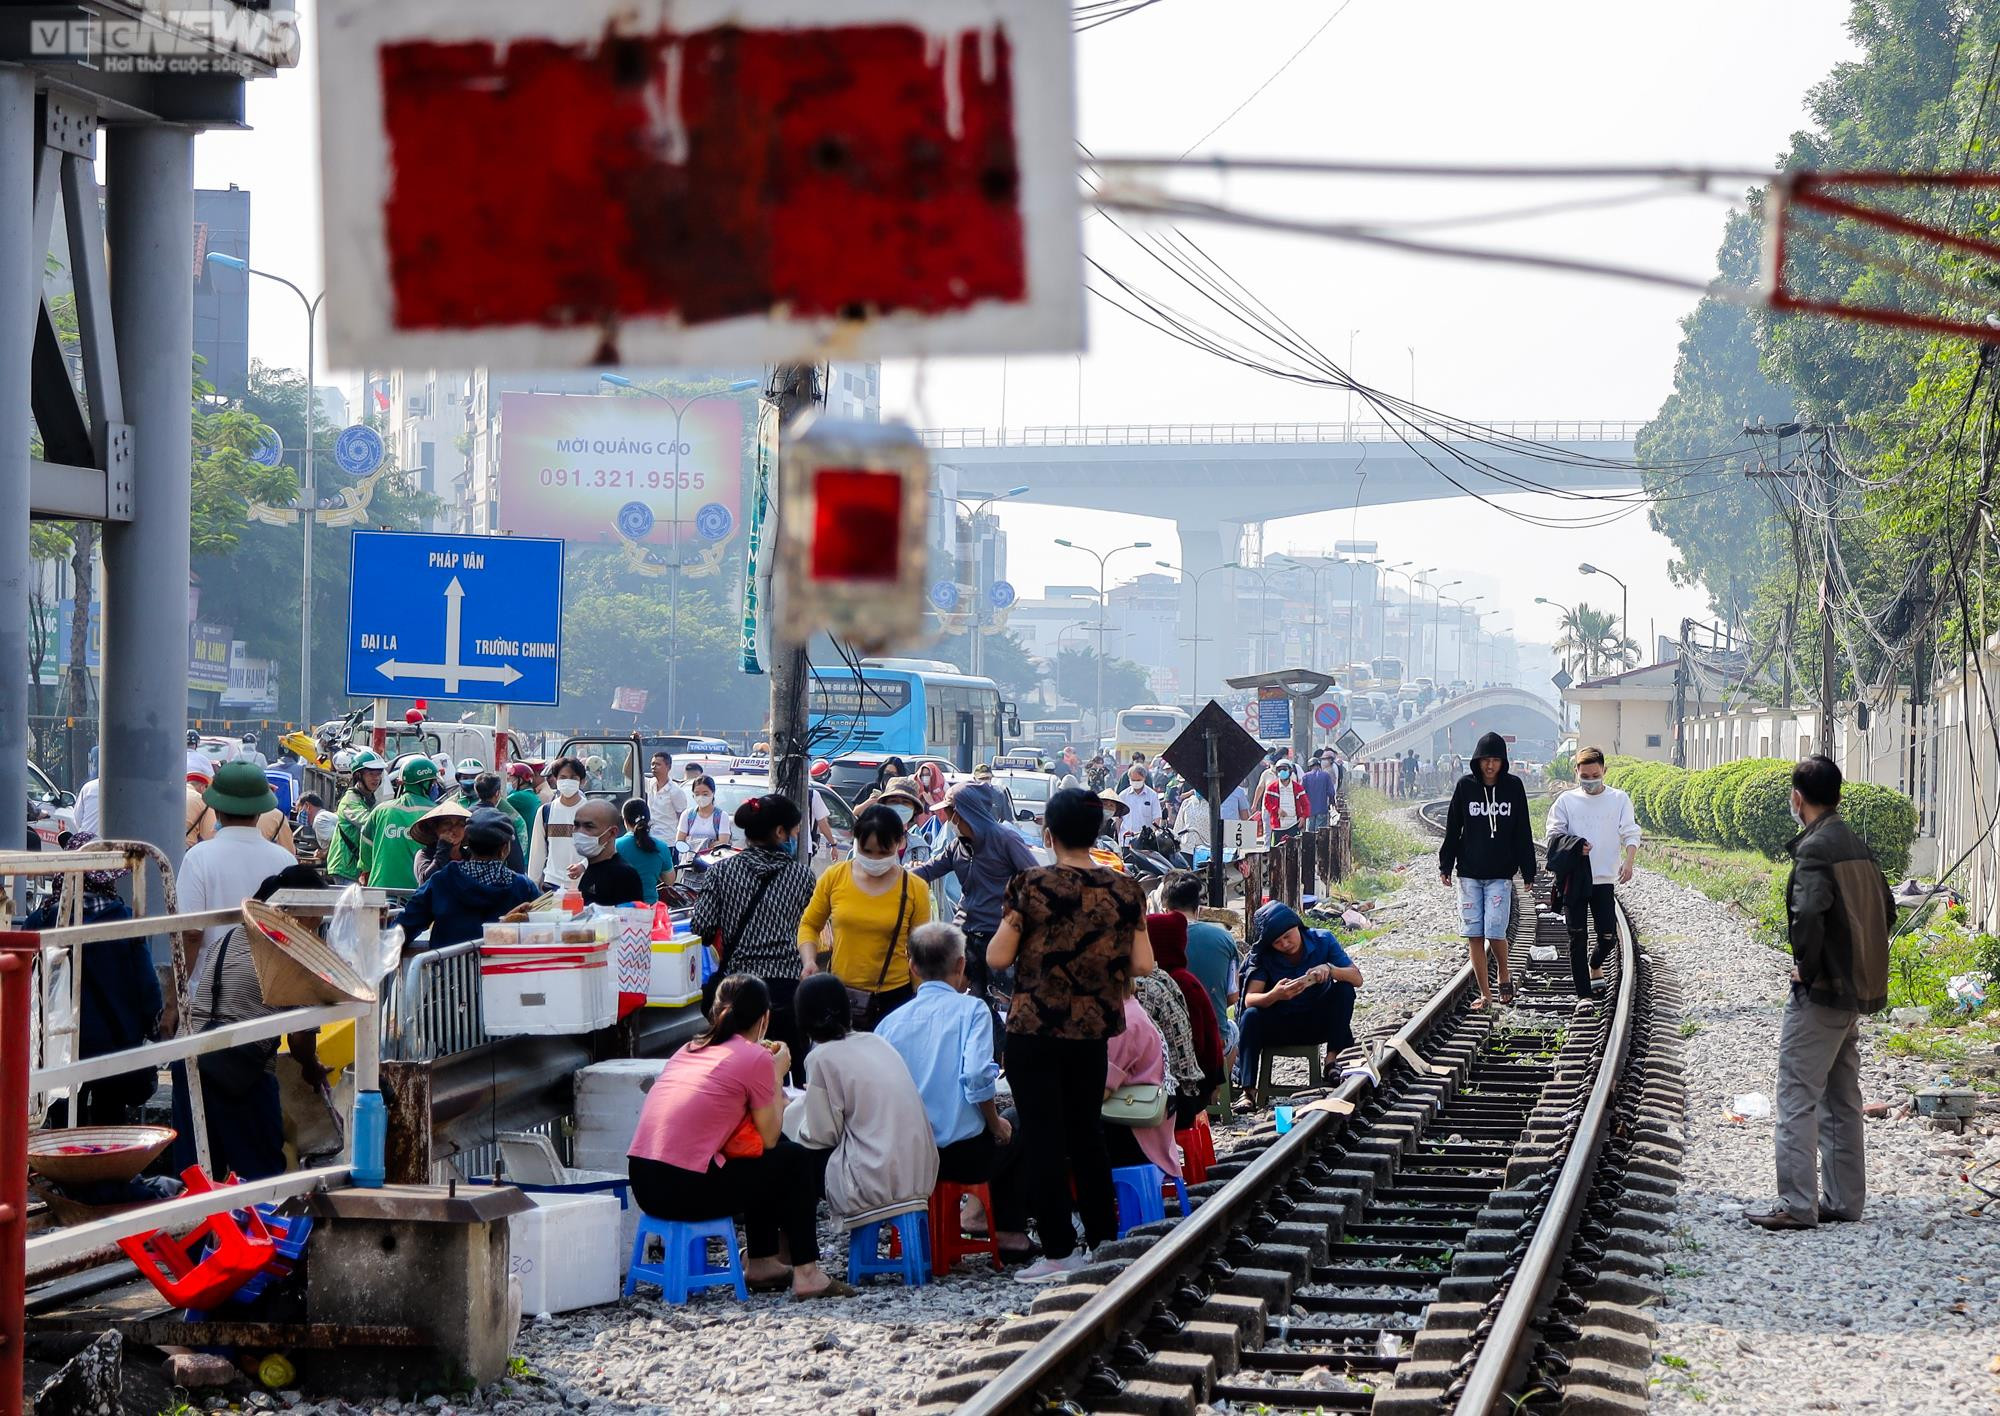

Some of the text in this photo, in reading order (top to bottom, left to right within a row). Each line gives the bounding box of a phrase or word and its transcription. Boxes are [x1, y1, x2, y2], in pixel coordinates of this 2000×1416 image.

[557, 436, 691, 456] MỜI QUẢNG CÁO
[540, 468, 706, 490] 091.321.9555
[429, 550, 484, 569] PHÁP VÂN
[361, 634, 397, 652] ĐẠI LA
[475, 637, 556, 658] TRƯỜNG CHINH
[417, 768, 433, 776] Grab
[1469, 802, 1512, 816] GUCCI
[384, 824, 412, 839] Gra
[1237, 823, 1242, 832] 2
[1236, 834, 1242, 847] 5
